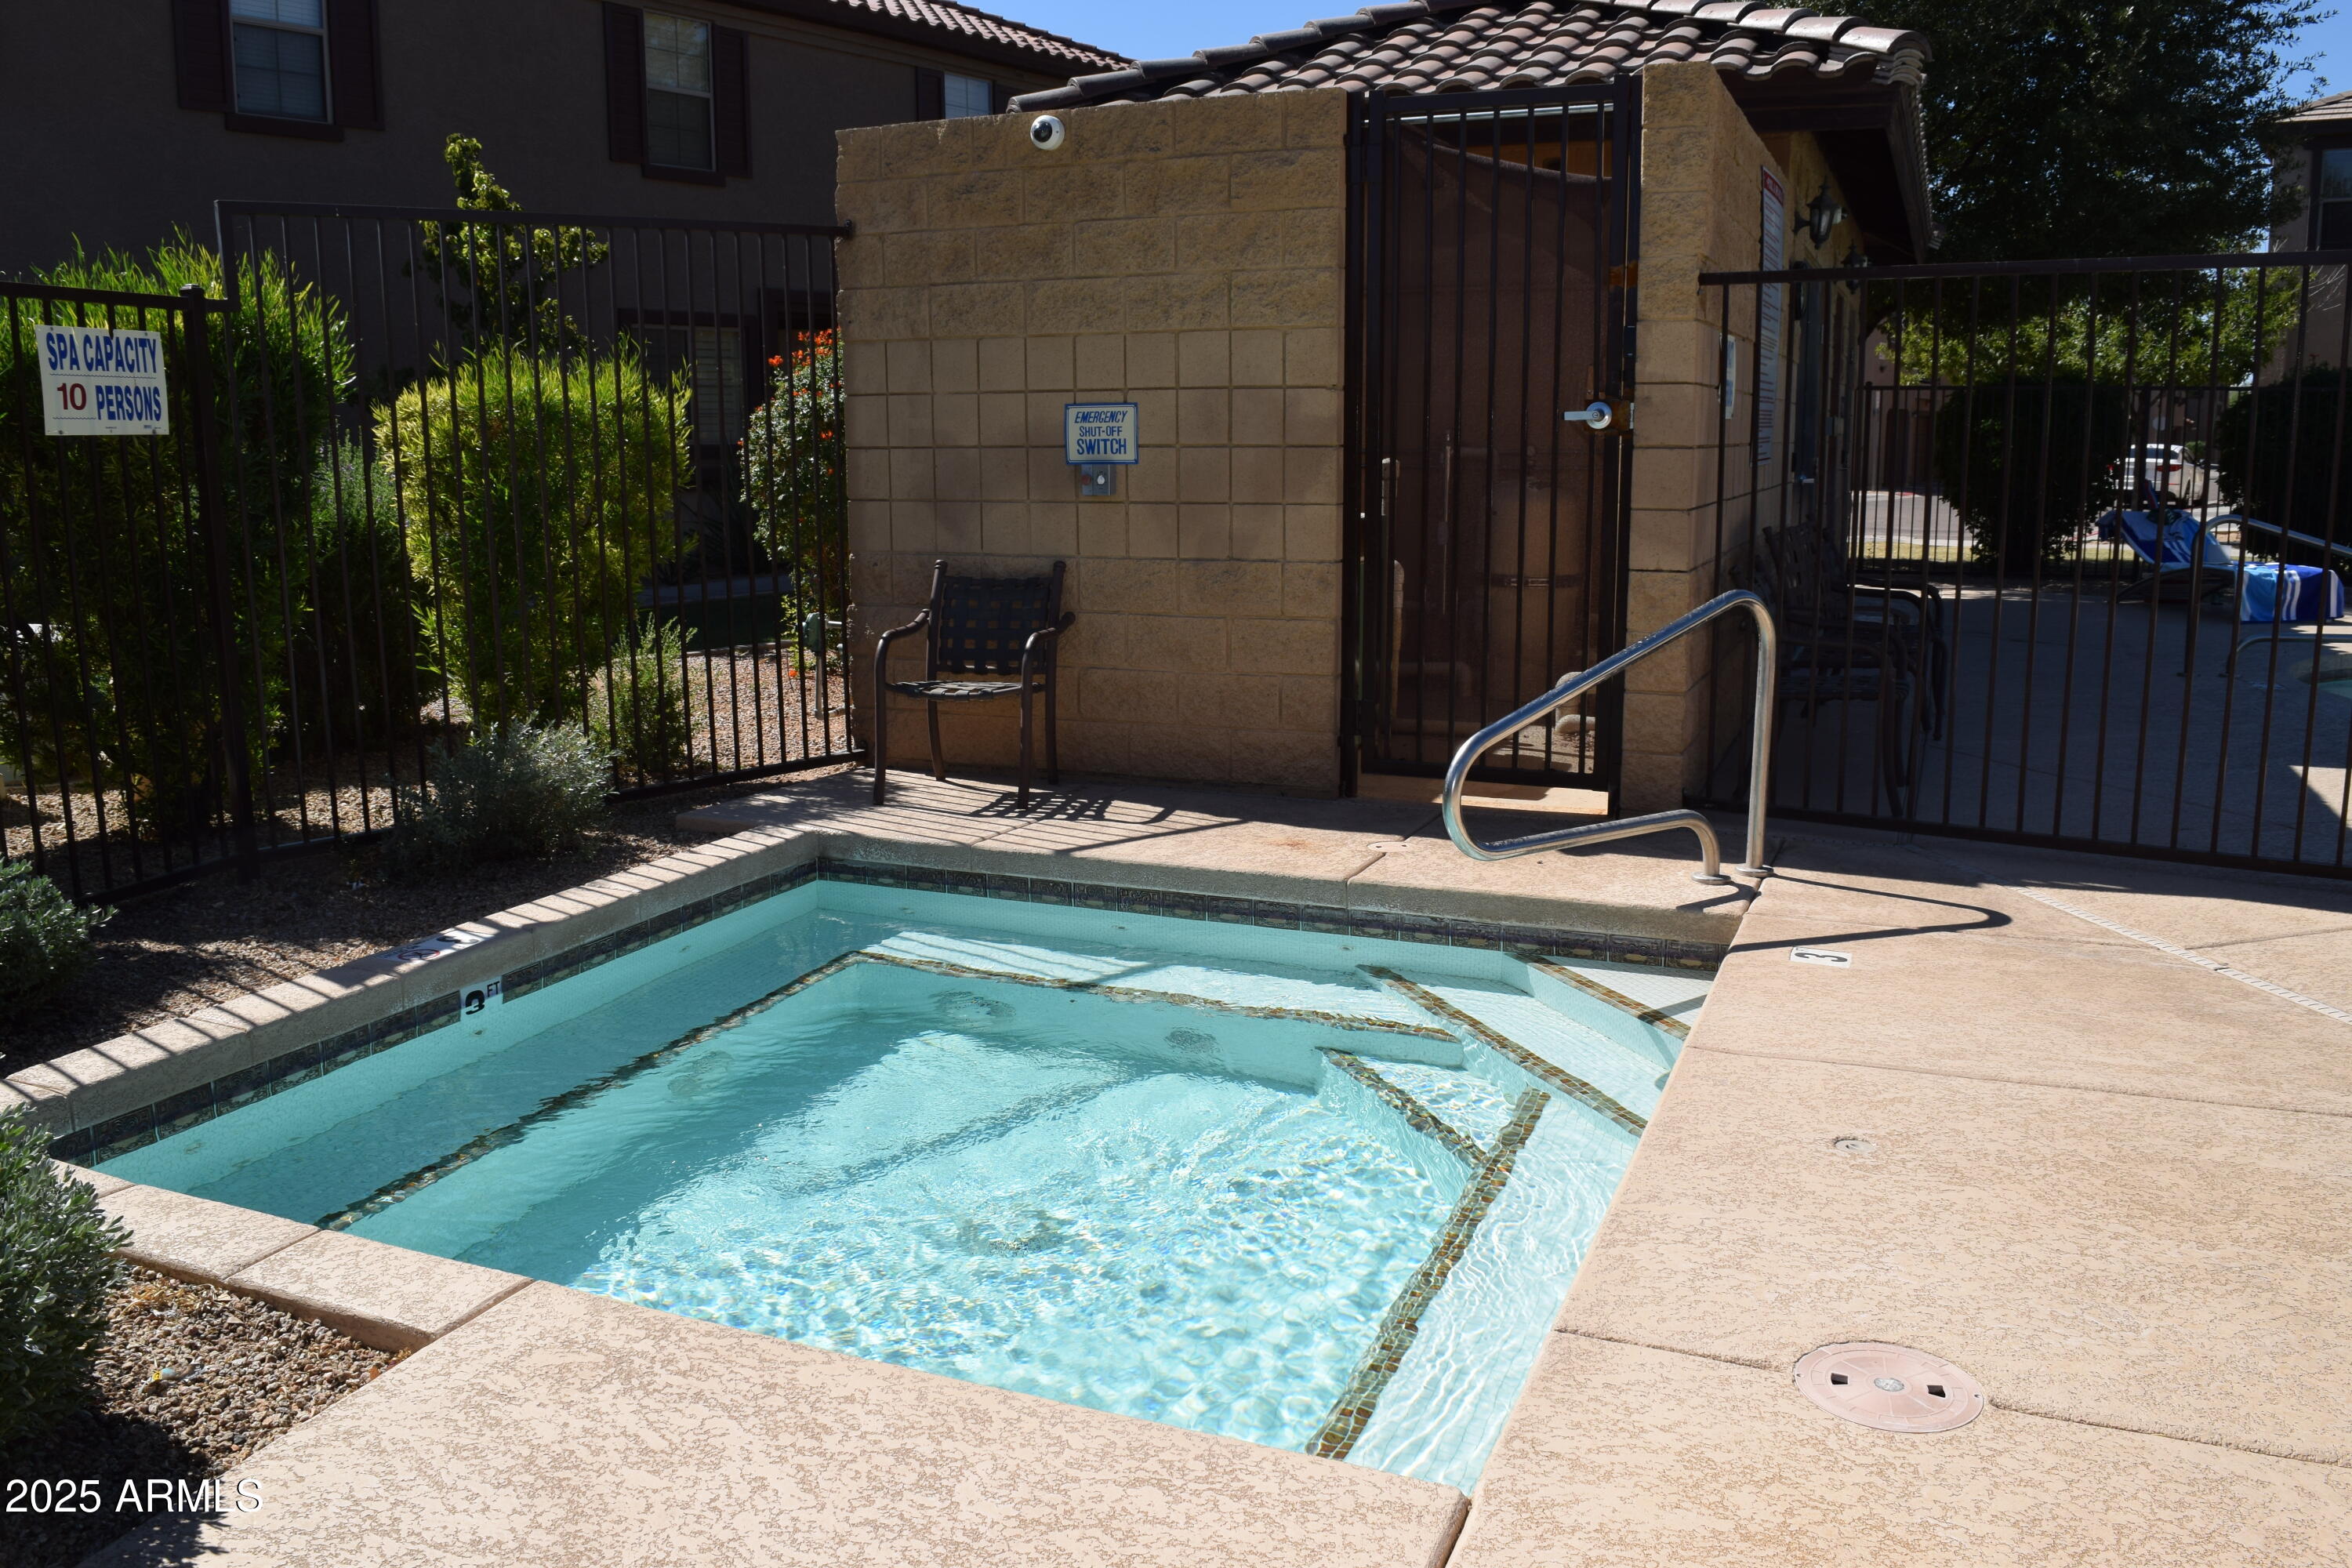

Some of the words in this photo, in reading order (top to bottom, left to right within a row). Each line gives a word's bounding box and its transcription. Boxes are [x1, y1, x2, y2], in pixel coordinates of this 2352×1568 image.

[46, 332, 80, 370] SPA
[83, 334, 157, 373] CAPACITY
[57, 383, 87, 410] 10
[95, 385, 162, 421] PERSONS
[1074, 410, 1127, 423] EMERGENCY
[1079, 426, 1123, 437] SHUT-OFF
[1076, 438, 1127, 455] SWITCH
[1795, 953, 1848, 962] 3
[465, 989, 485, 1015] 3
[487, 981, 500, 998] FT
